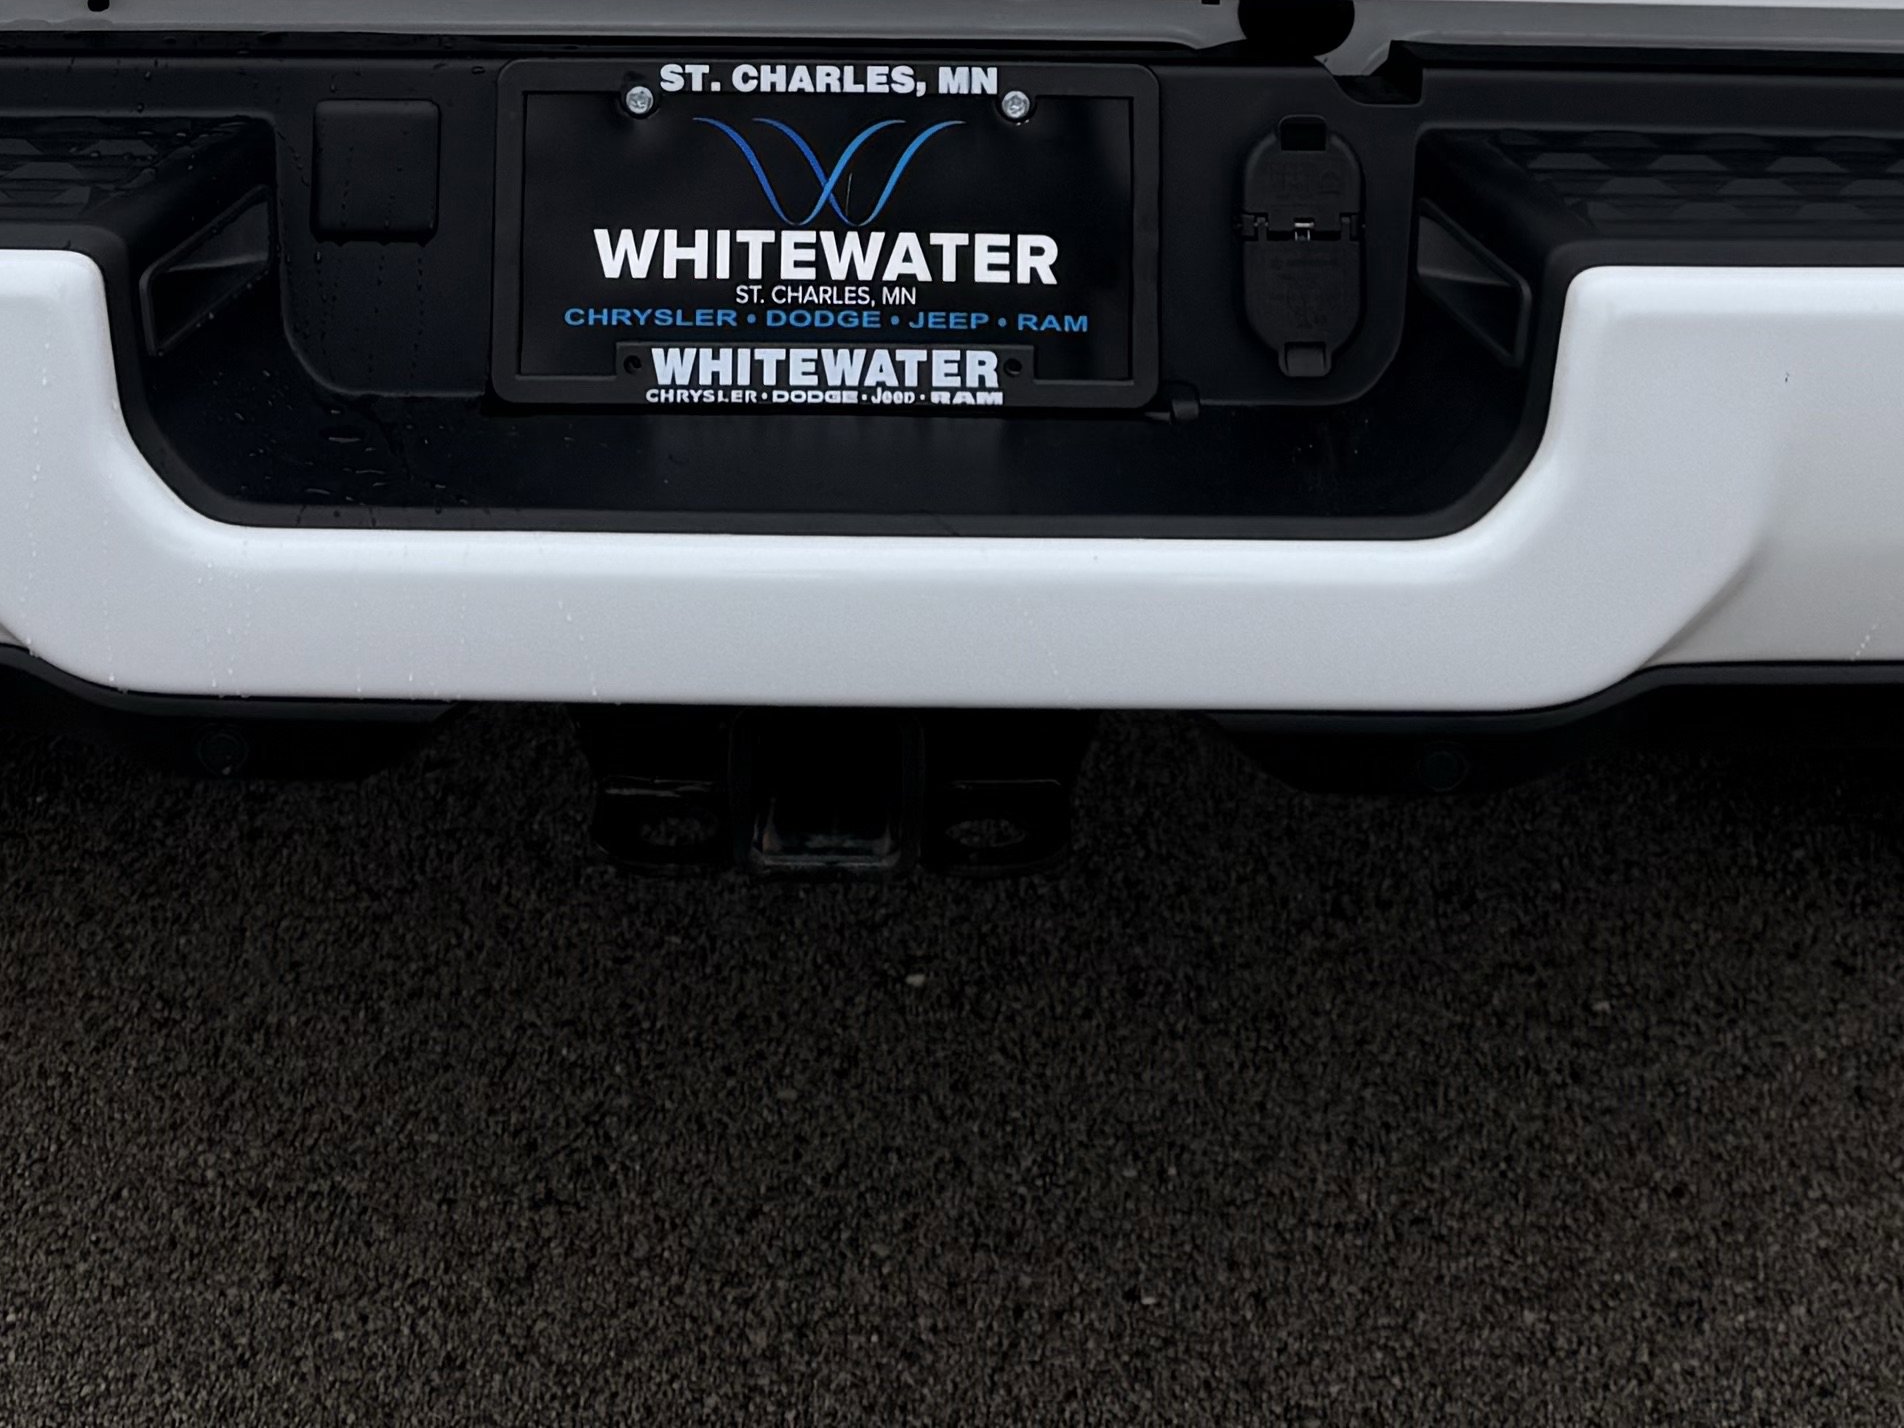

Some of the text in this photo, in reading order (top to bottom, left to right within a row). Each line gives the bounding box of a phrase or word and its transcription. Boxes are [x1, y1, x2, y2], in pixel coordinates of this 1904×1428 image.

[659, 63, 998, 97] ST. CHARLES, MN
[593, 228, 1058, 285] WHITEWATER
[735, 284, 916, 308] ST. CHARLES, MN
[563, 307, 1088, 332] CHRYSLER DODGE JEEP RAM
[651, 347, 999, 388] WHITEWATER
[645, 388, 757, 404] CHRYSLER
[772, 389, 859, 405] DODGE
[930, 390, 1004, 406] RAM
